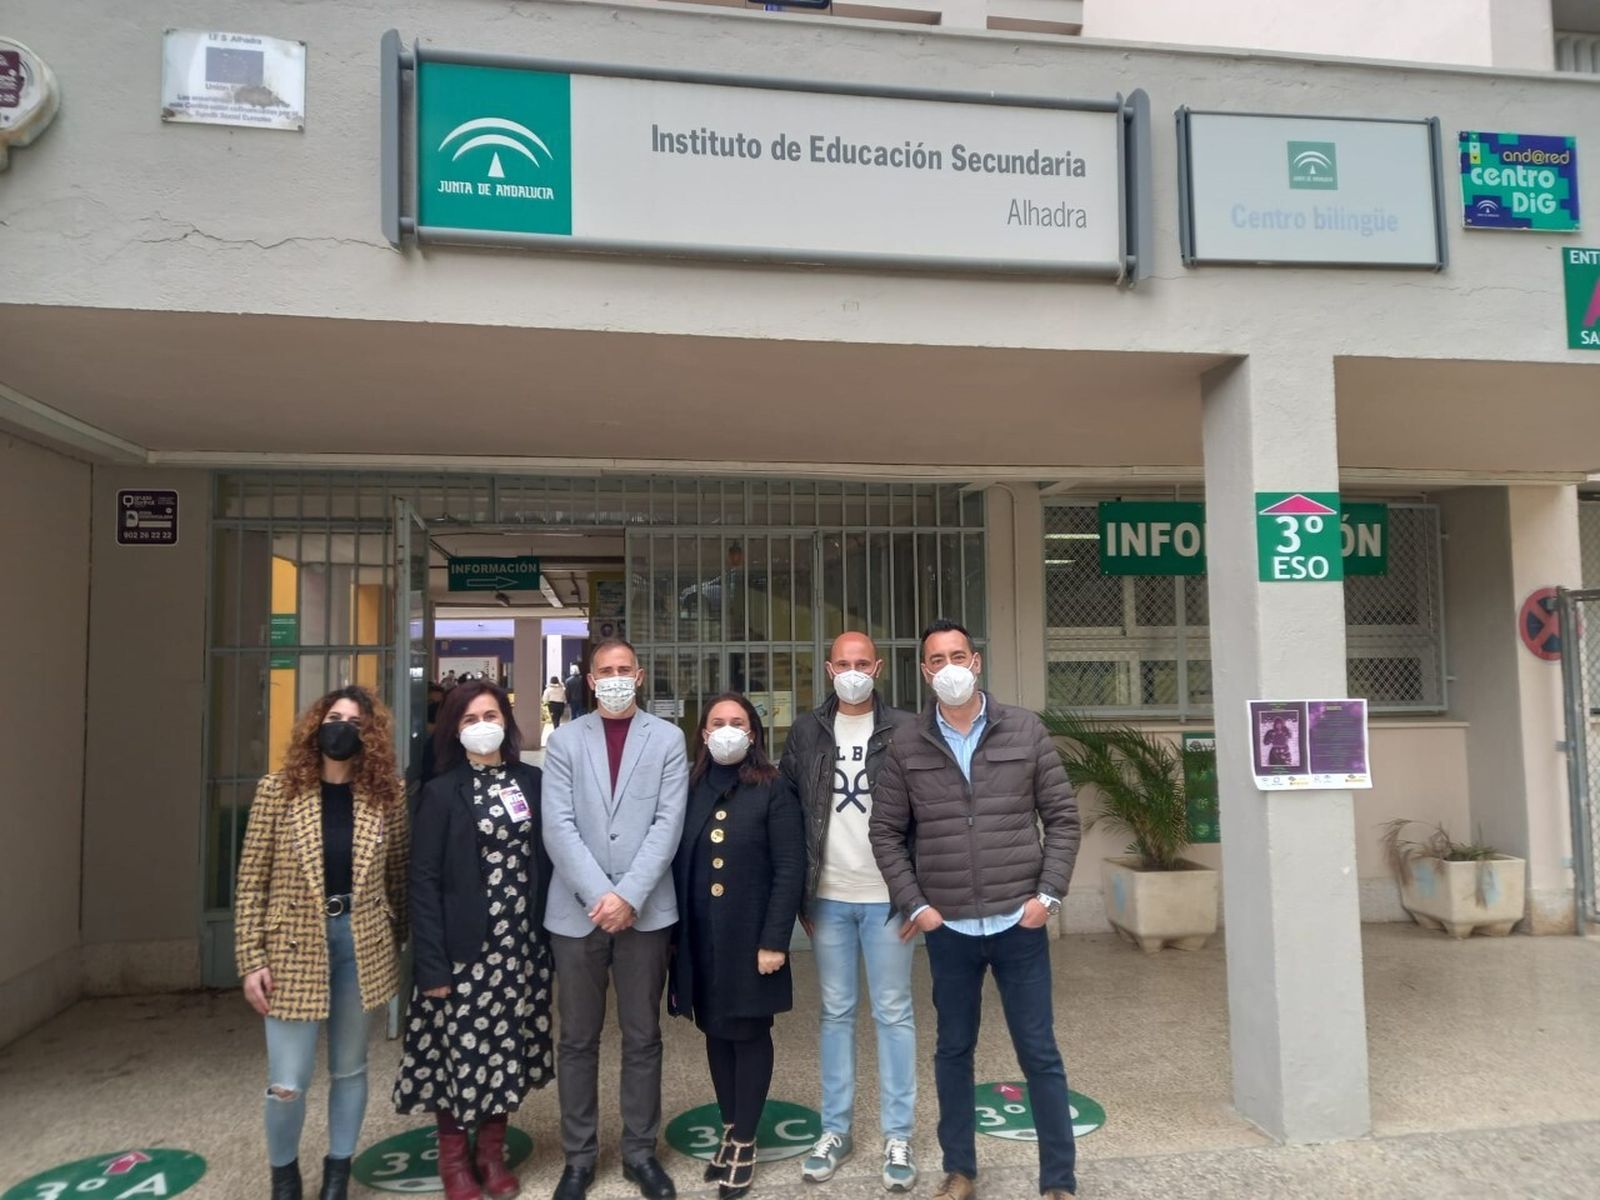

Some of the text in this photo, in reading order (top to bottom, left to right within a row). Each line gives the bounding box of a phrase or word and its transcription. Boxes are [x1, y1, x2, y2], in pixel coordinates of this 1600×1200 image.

[651, 123, 1087, 178] Instituto de Educación Secundaria
[1502, 148, 1570, 165] and@red
[1470, 165, 1556, 189] centro
[437, 180, 555, 200] JUNTA DE ANDALUCIA
[1007, 198, 1088, 229] Alhadra
[1512, 191, 1557, 214] DiG
[1231, 203, 1400, 237] Centro bilingüe
[1569, 249, 1600, 265] ENT
[1580, 330, 1600, 345] SA
[1274, 514, 1325, 555] 3º
[451, 561, 537, 575] INFORMACIÓN
[1273, 555, 1330, 580] ESO
[774, 1118, 816, 1141] C
[112, 1171, 169, 1200] A
